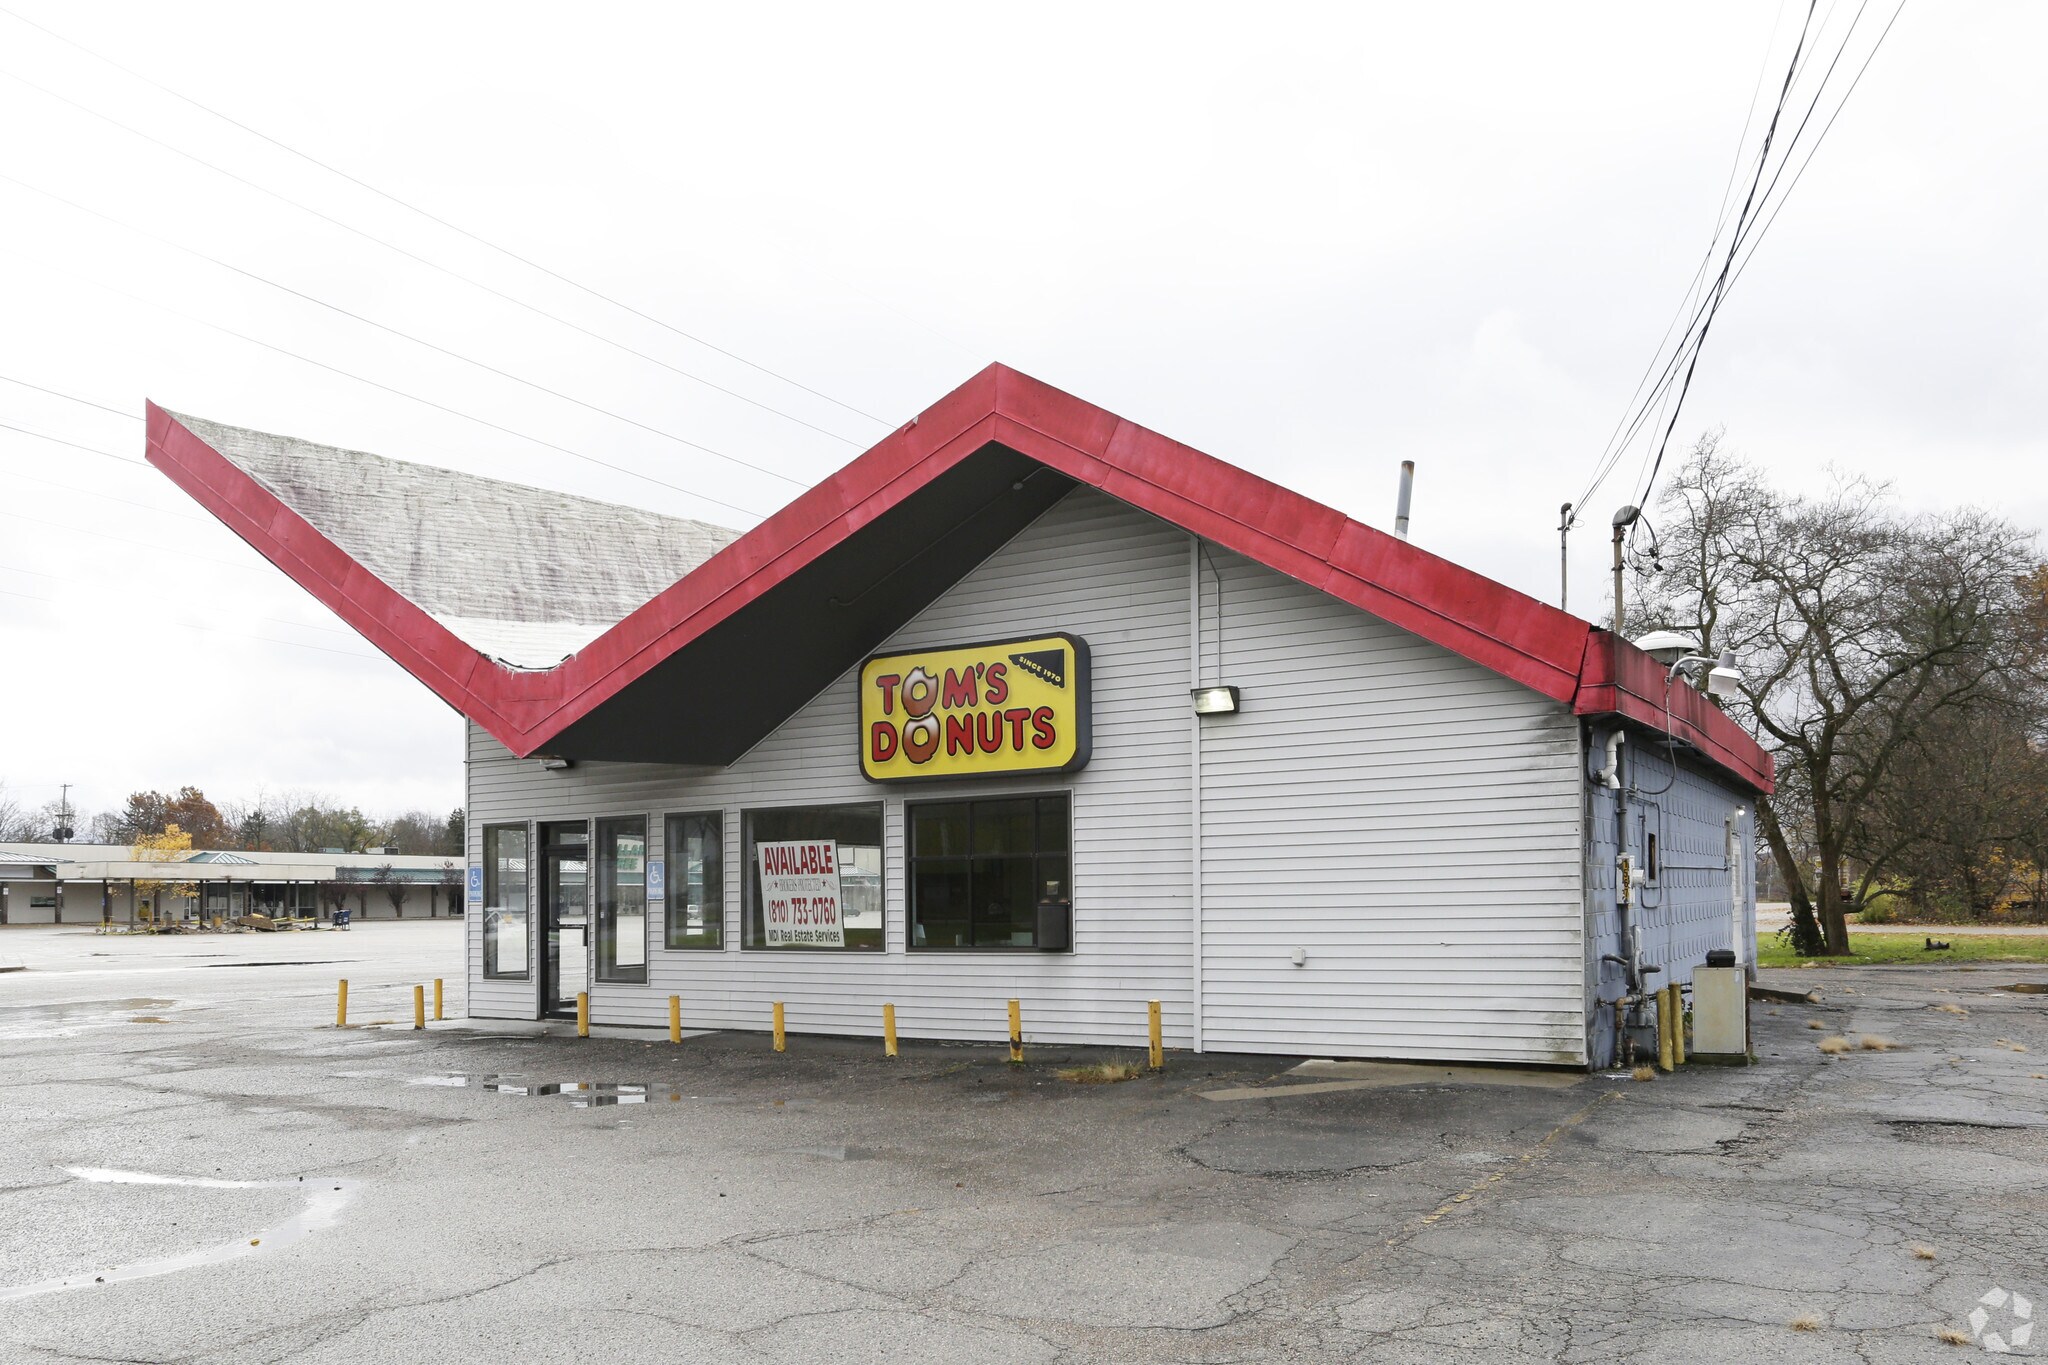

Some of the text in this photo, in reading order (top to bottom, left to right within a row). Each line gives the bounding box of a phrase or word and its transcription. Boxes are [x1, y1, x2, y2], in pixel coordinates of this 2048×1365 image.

[1018, 656, 1061, 682] SINCE 1970
[876, 662, 1008, 718] TOM'S
[871, 706, 1056, 764] DONUTS
[764, 845, 833, 875] AVAILABLE
[768, 897, 836, 925] (810) 733-0760
[781, 929, 793, 942] Real
[795, 929, 813, 942] Estate
[815, 928, 840, 942] Services
